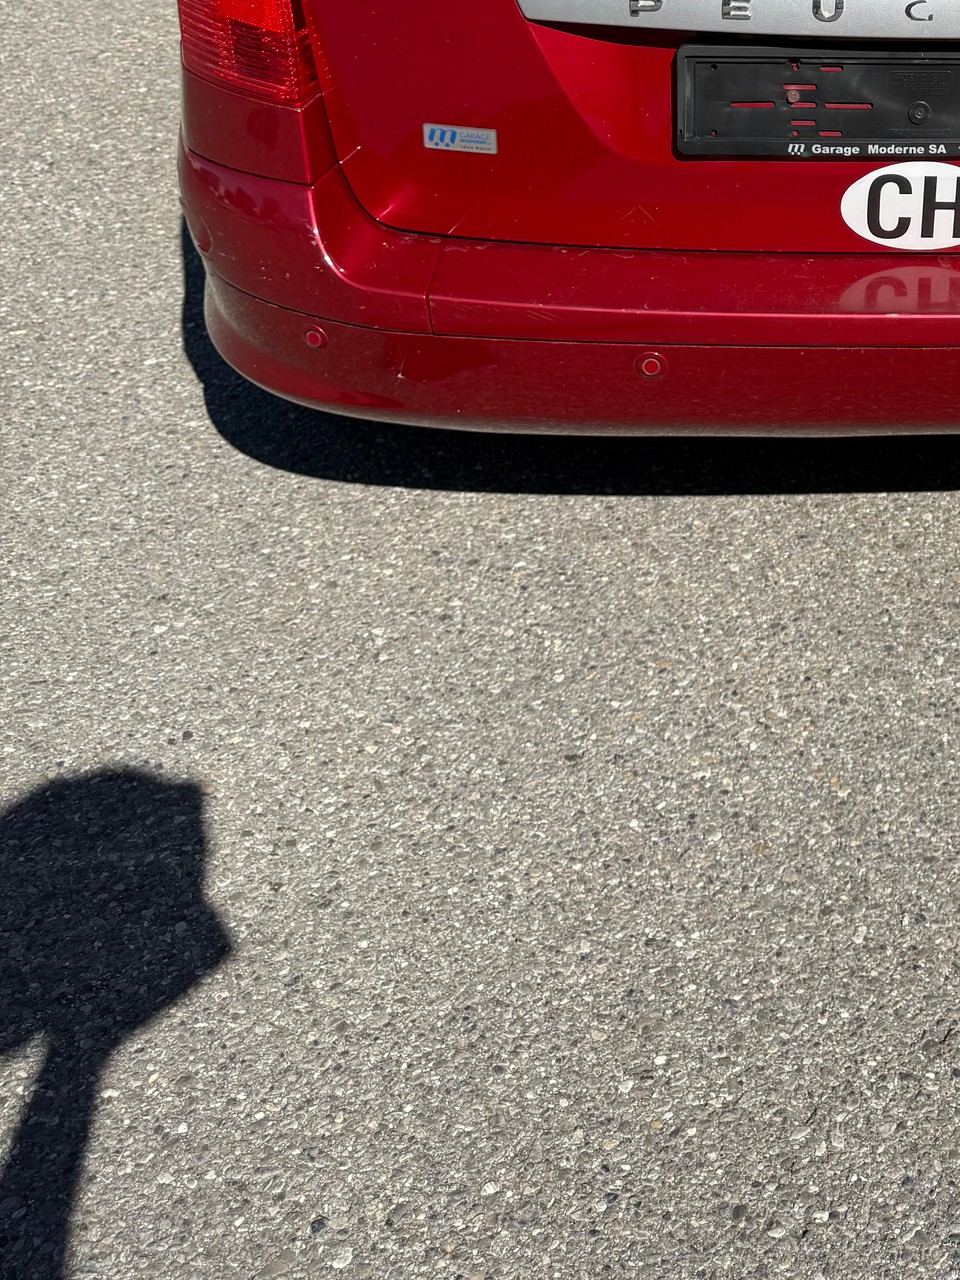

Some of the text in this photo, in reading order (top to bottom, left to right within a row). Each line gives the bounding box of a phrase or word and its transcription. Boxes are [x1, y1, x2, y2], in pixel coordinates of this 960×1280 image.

[811, 144, 860, 156] Garage
[867, 144, 925, 154] Moderne
[928, 144, 947, 154] SA
